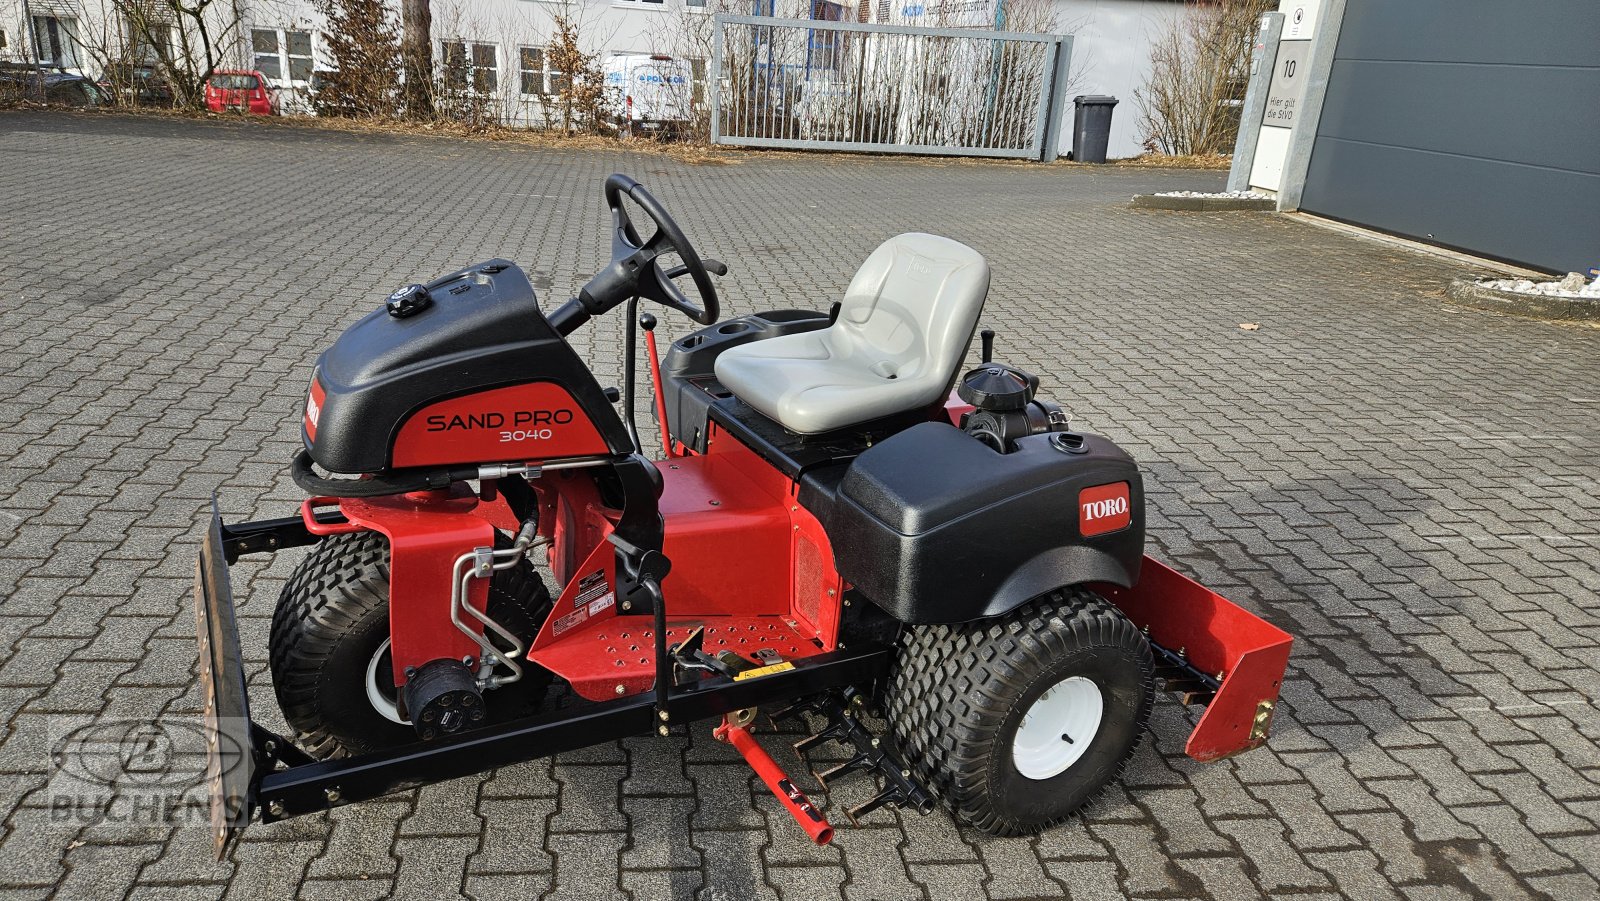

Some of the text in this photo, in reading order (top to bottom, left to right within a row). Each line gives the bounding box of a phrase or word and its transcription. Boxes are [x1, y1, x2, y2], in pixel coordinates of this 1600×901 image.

[1284, 59, 1297, 78] 10
[1270, 96, 1296, 110] Hier gilt
[1267, 109, 1293, 120] die StVO
[426, 409, 574, 432] SAND PRO
[499, 429, 552, 442] 3040
